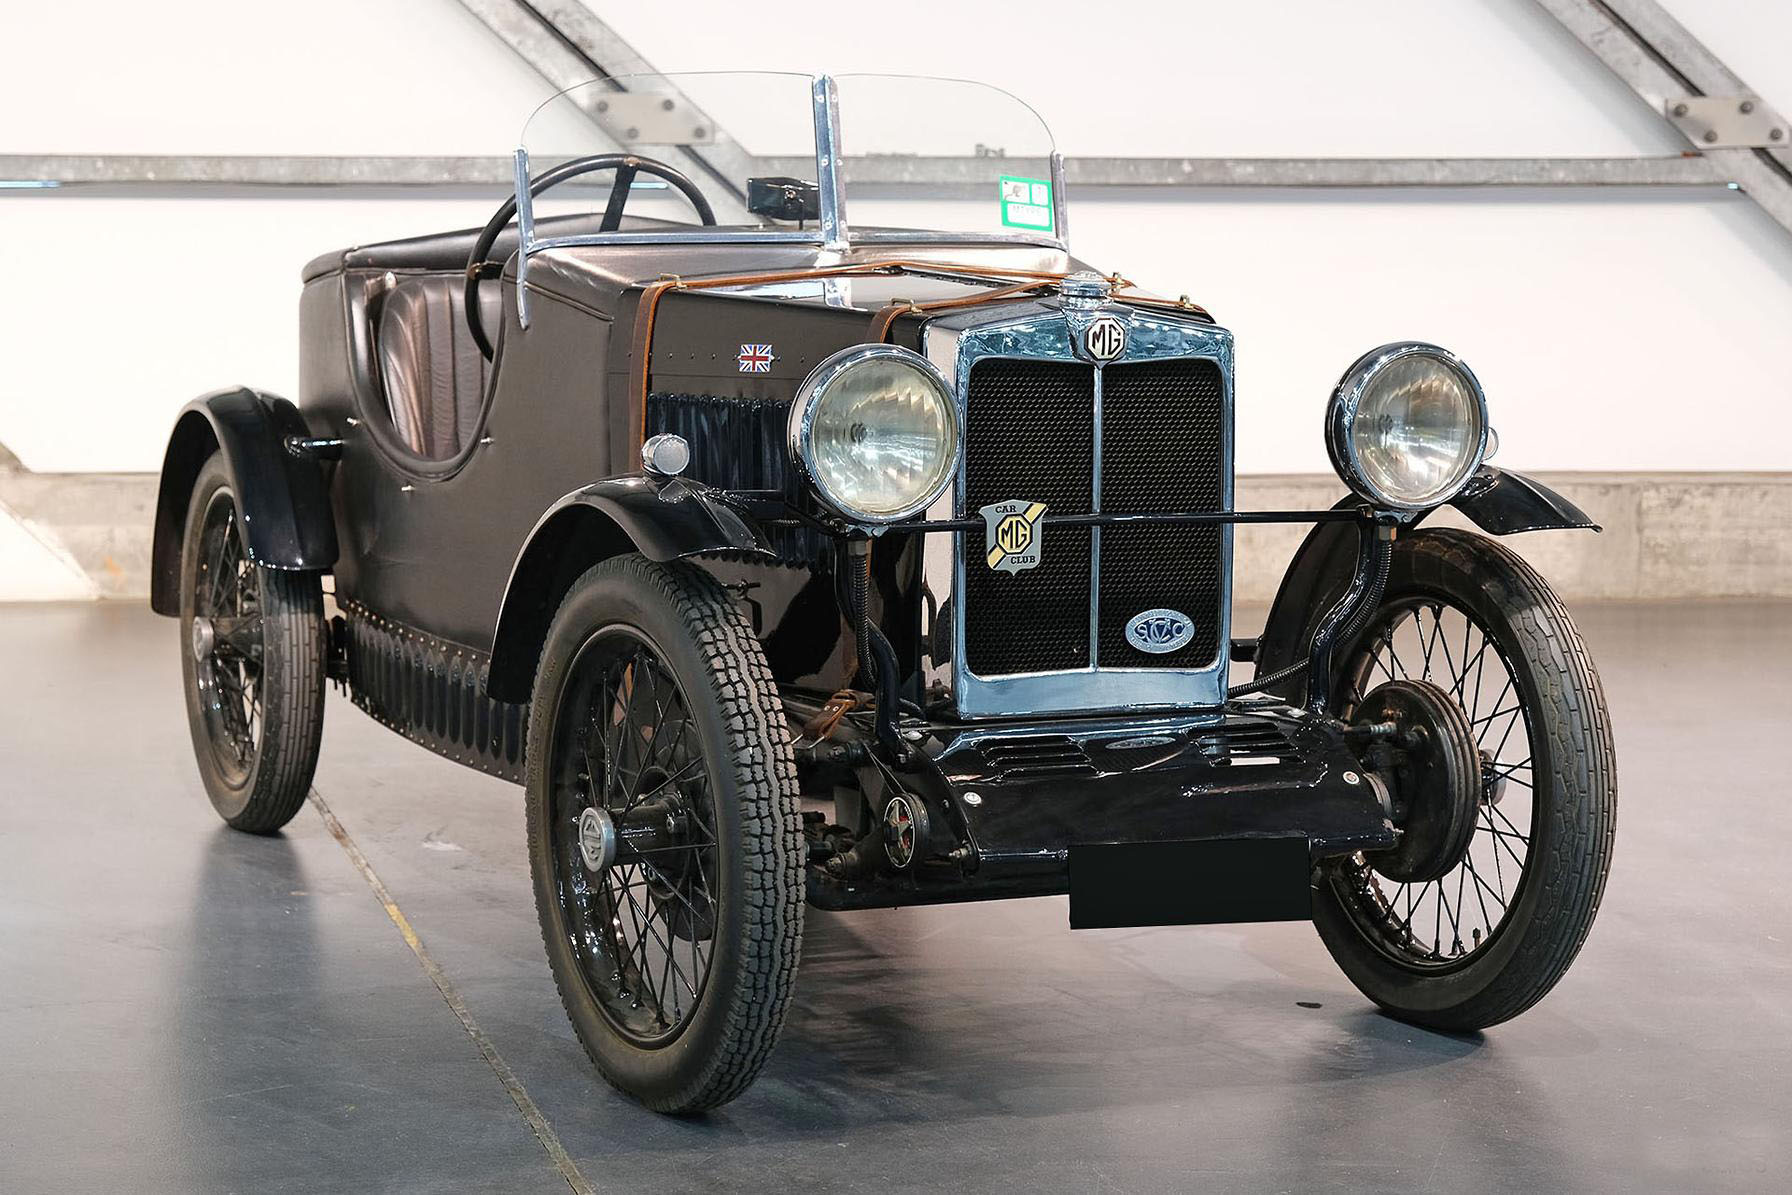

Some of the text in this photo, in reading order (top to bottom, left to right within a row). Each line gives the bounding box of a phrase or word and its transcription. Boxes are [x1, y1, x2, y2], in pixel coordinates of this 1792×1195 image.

[1092, 324, 1121, 356] MG
[995, 504, 1017, 513] CAR
[1001, 519, 1028, 549] MG
[1010, 555, 1036, 565] CLUB
